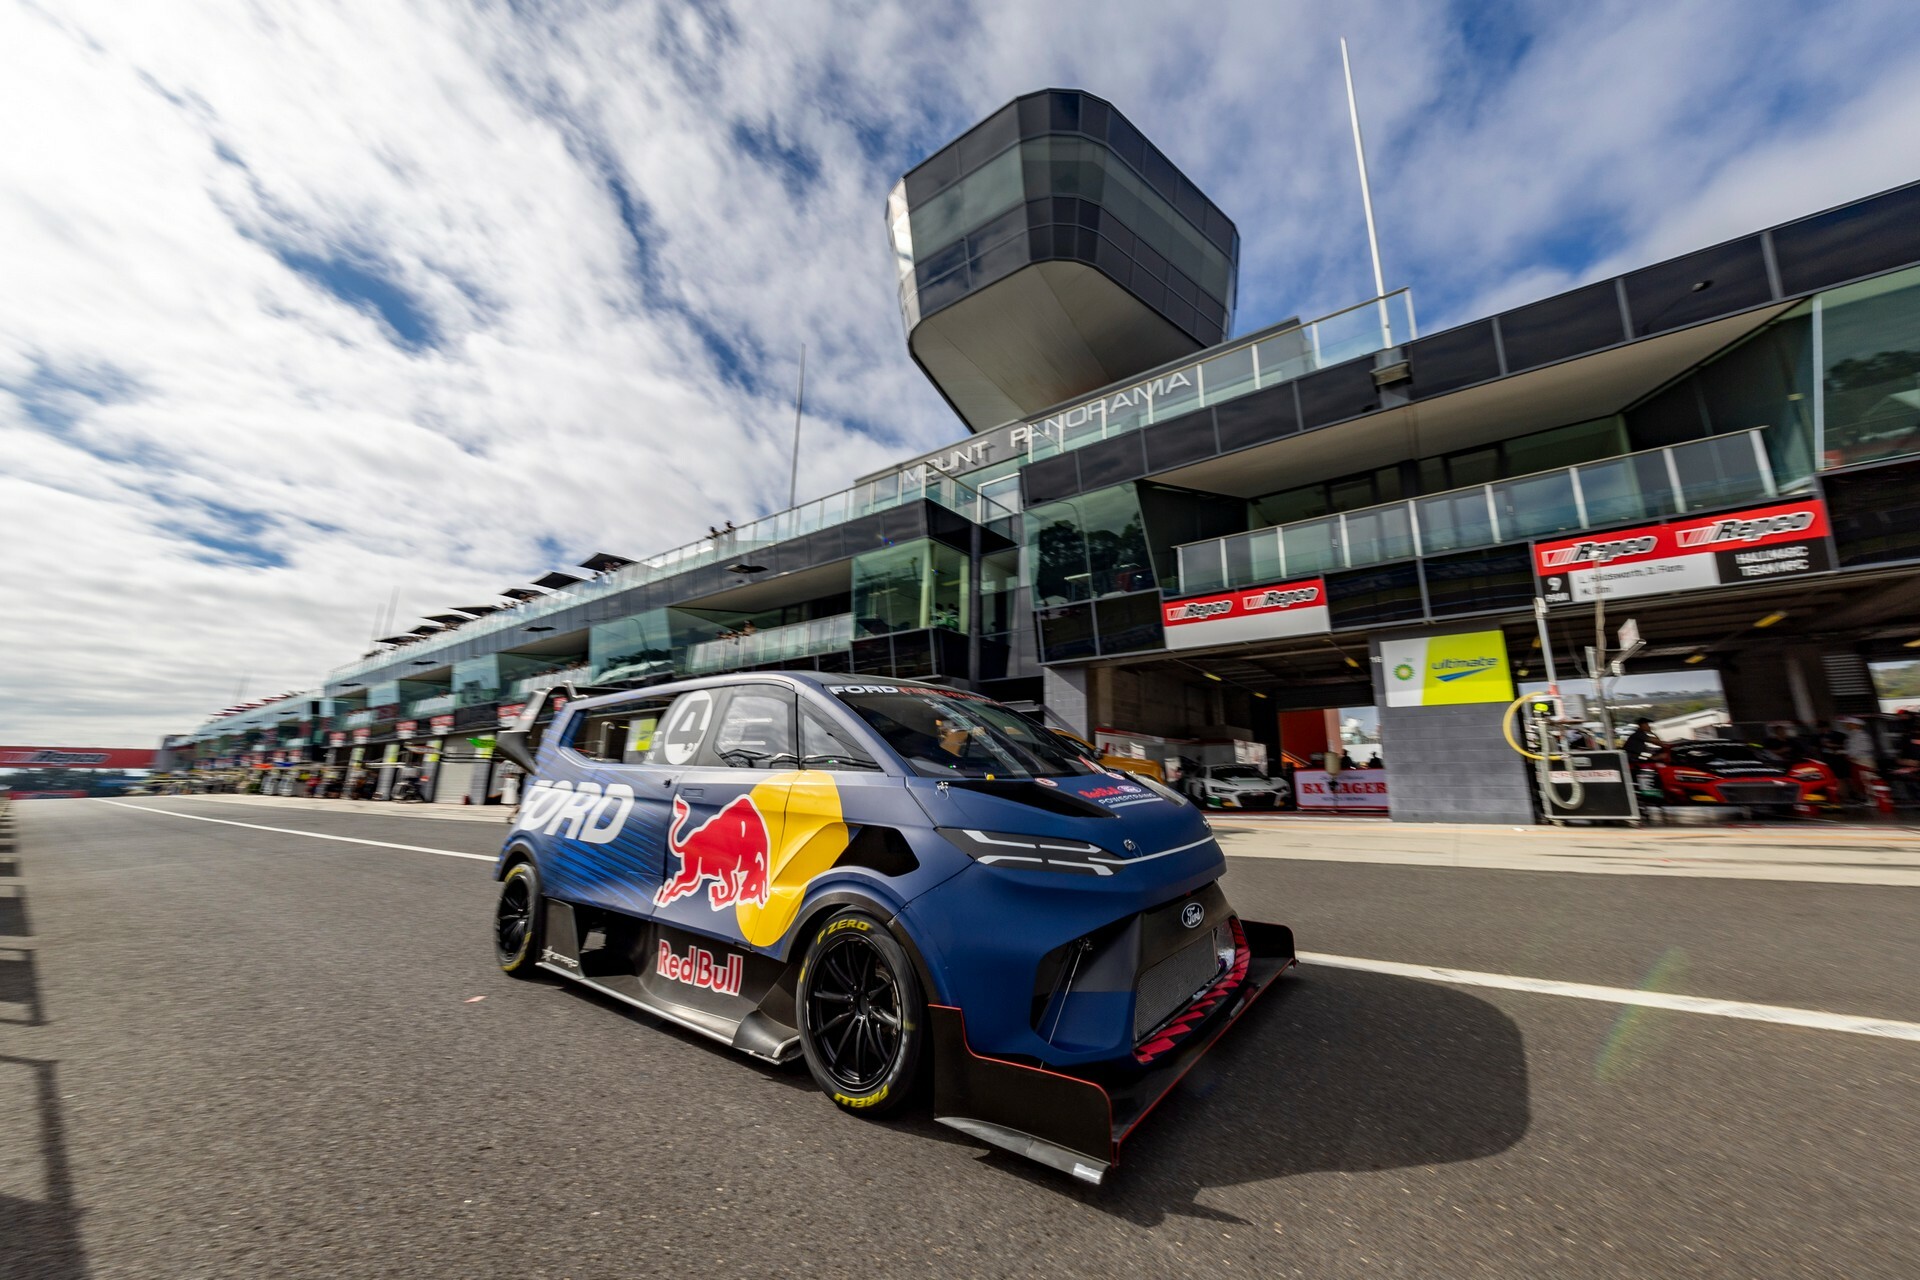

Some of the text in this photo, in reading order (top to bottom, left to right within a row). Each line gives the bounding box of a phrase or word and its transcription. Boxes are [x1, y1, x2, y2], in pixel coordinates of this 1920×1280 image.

[903, 372, 1192, 485] MOUNT PANORAMA
[1713, 511, 1815, 542] Repco
[1575, 535, 1658, 563] Repco
[1547, 577, 1562, 591] 9
[1184, 600, 1233, 619] Repco
[1264, 587, 1319, 608] Repco
[1431, 656, 1498, 670] ultimate
[828, 685, 899, 696] FORD
[667, 699, 710, 745] 4
[1328, 782, 1388, 794] AGER
[519, 780, 635, 844] FORD
[1185, 904, 1202, 926] Ford
[817, 919, 874, 945] P ZERO
[656, 939, 744, 997] Red Bull
[833, 1084, 889, 1108] PIRELLI
